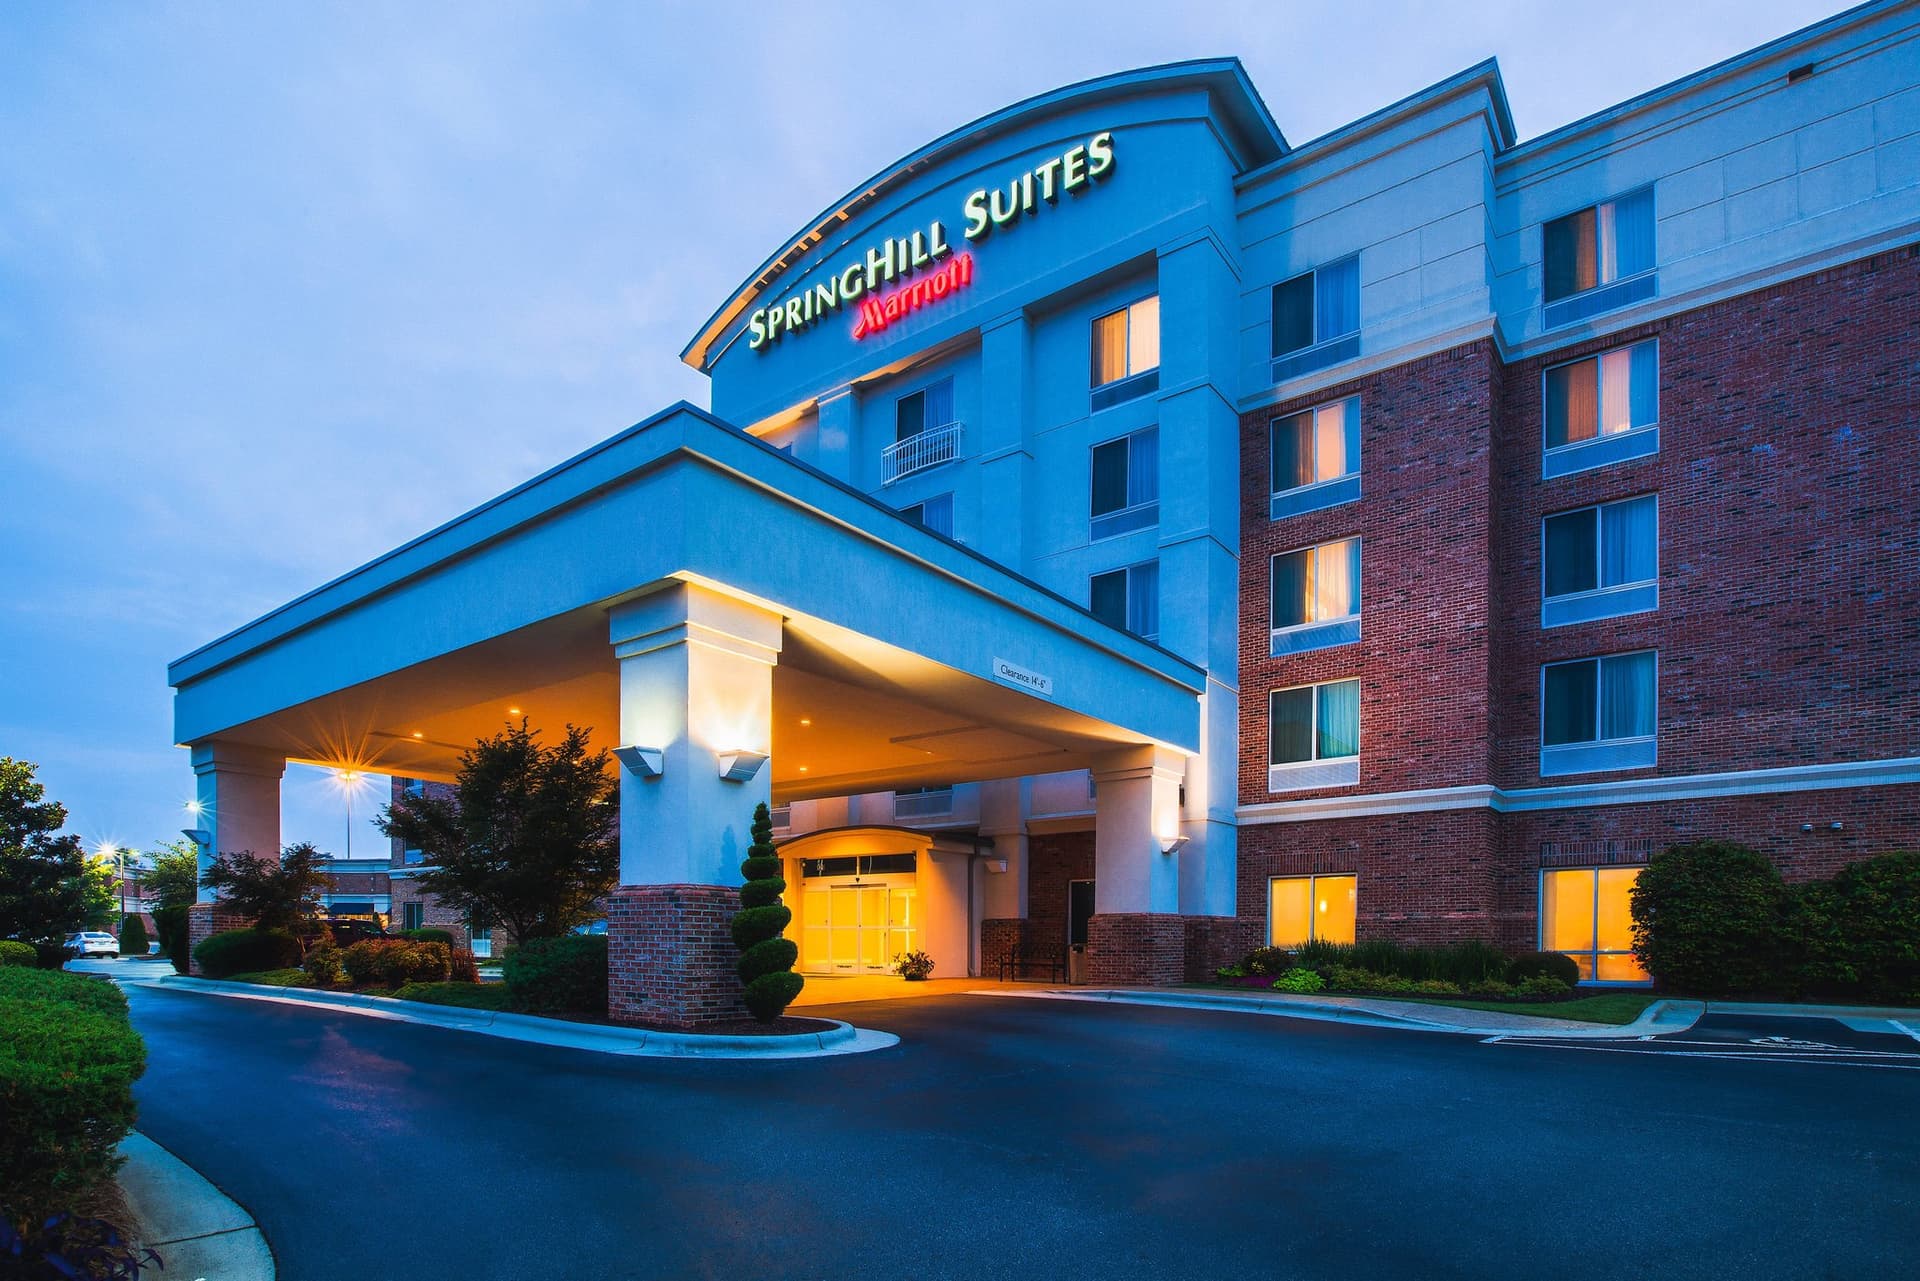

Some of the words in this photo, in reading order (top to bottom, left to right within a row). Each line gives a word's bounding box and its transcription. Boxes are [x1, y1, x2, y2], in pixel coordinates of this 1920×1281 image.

[749, 221, 948, 349] SPRINGHILL
[964, 132, 1114, 240] SUITES
[852, 253, 972, 340] Marriott
[1001, 664, 1029, 683] Clearance
